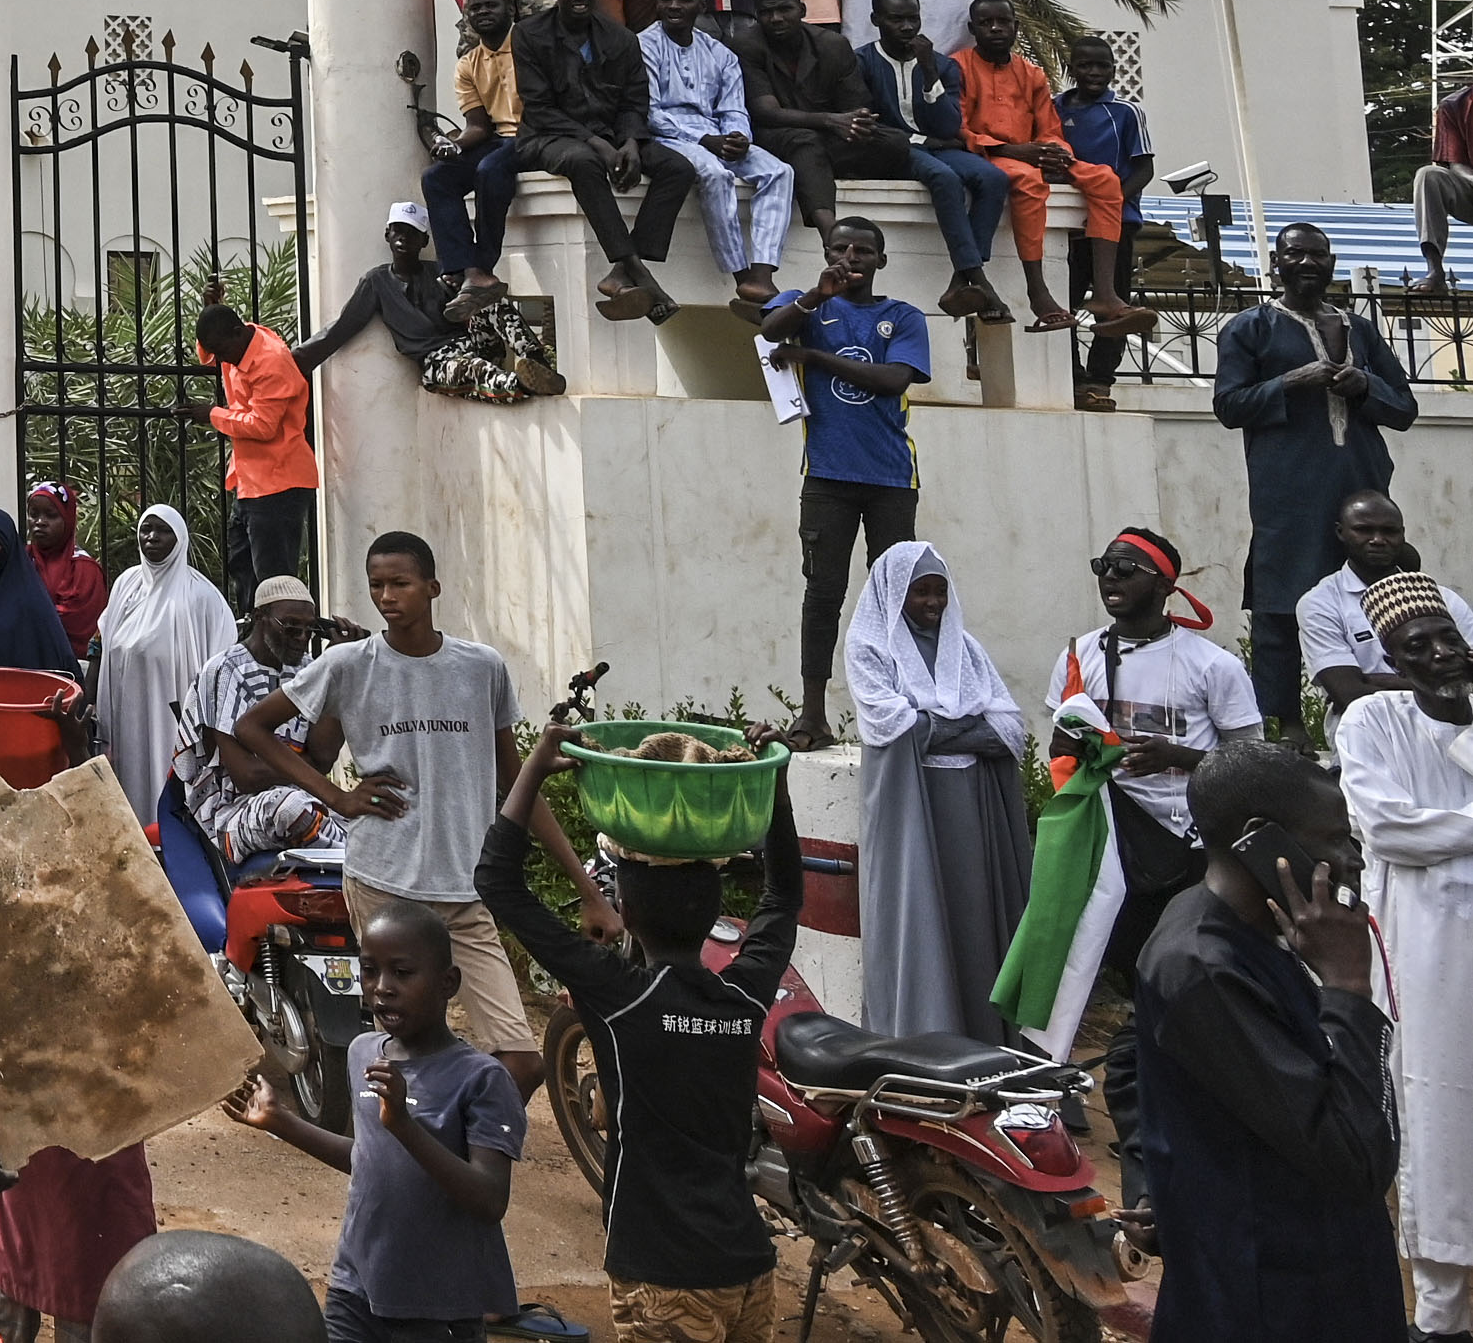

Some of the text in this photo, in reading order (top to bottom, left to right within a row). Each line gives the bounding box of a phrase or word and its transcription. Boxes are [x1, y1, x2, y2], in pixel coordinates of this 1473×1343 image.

[426, 719, 470, 735] JUNIOR
[661, 1013, 753, 1036] 新锐篮球训练营
